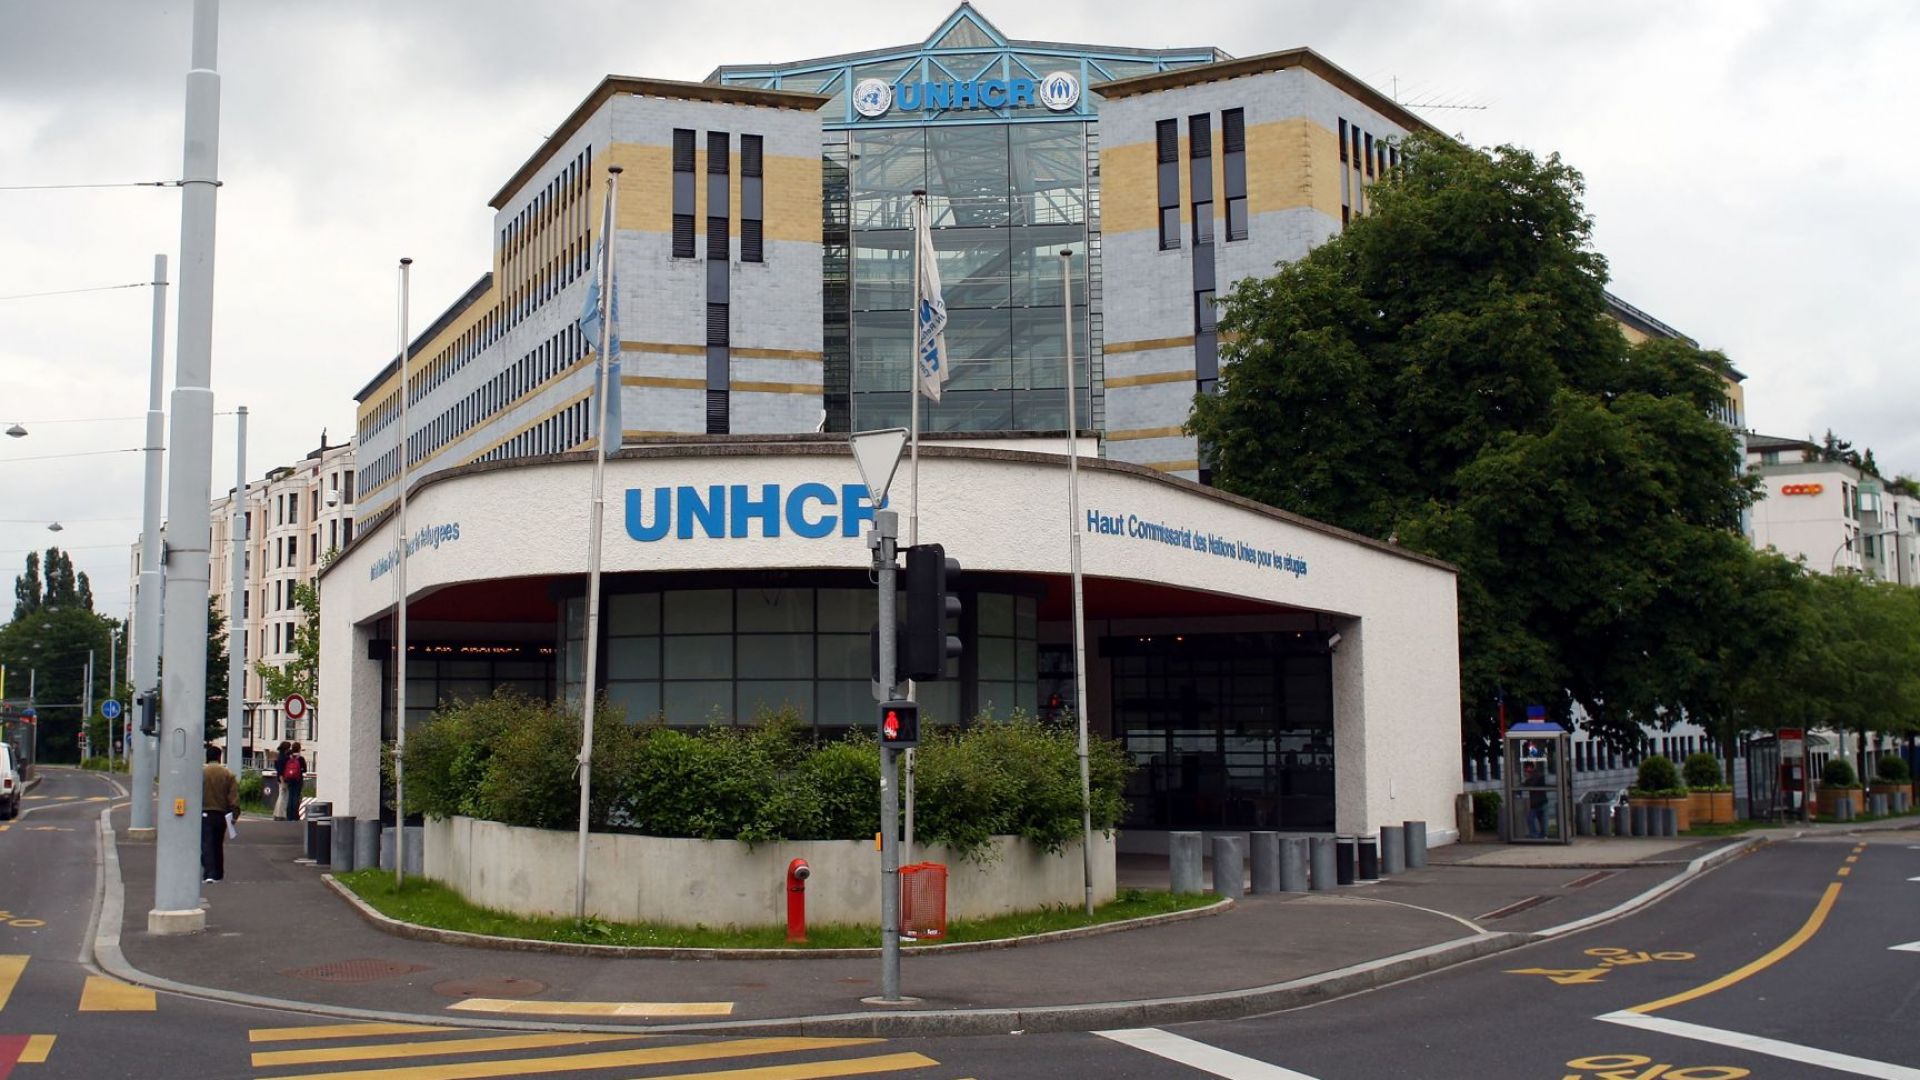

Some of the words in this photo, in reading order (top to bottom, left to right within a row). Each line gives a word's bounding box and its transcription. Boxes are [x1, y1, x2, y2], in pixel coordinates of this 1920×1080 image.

[896, 79, 1035, 111] UNHCR
[1087, 509, 1124, 536] Haut
[1128, 514, 1192, 549] Commissariat
[1193, 530, 1207, 552] des
[1208, 533, 1236, 559] Nations
[1237, 540, 1257, 564] Unies
[1257, 550, 1272, 568] pour
[1273, 550, 1283, 570] les
